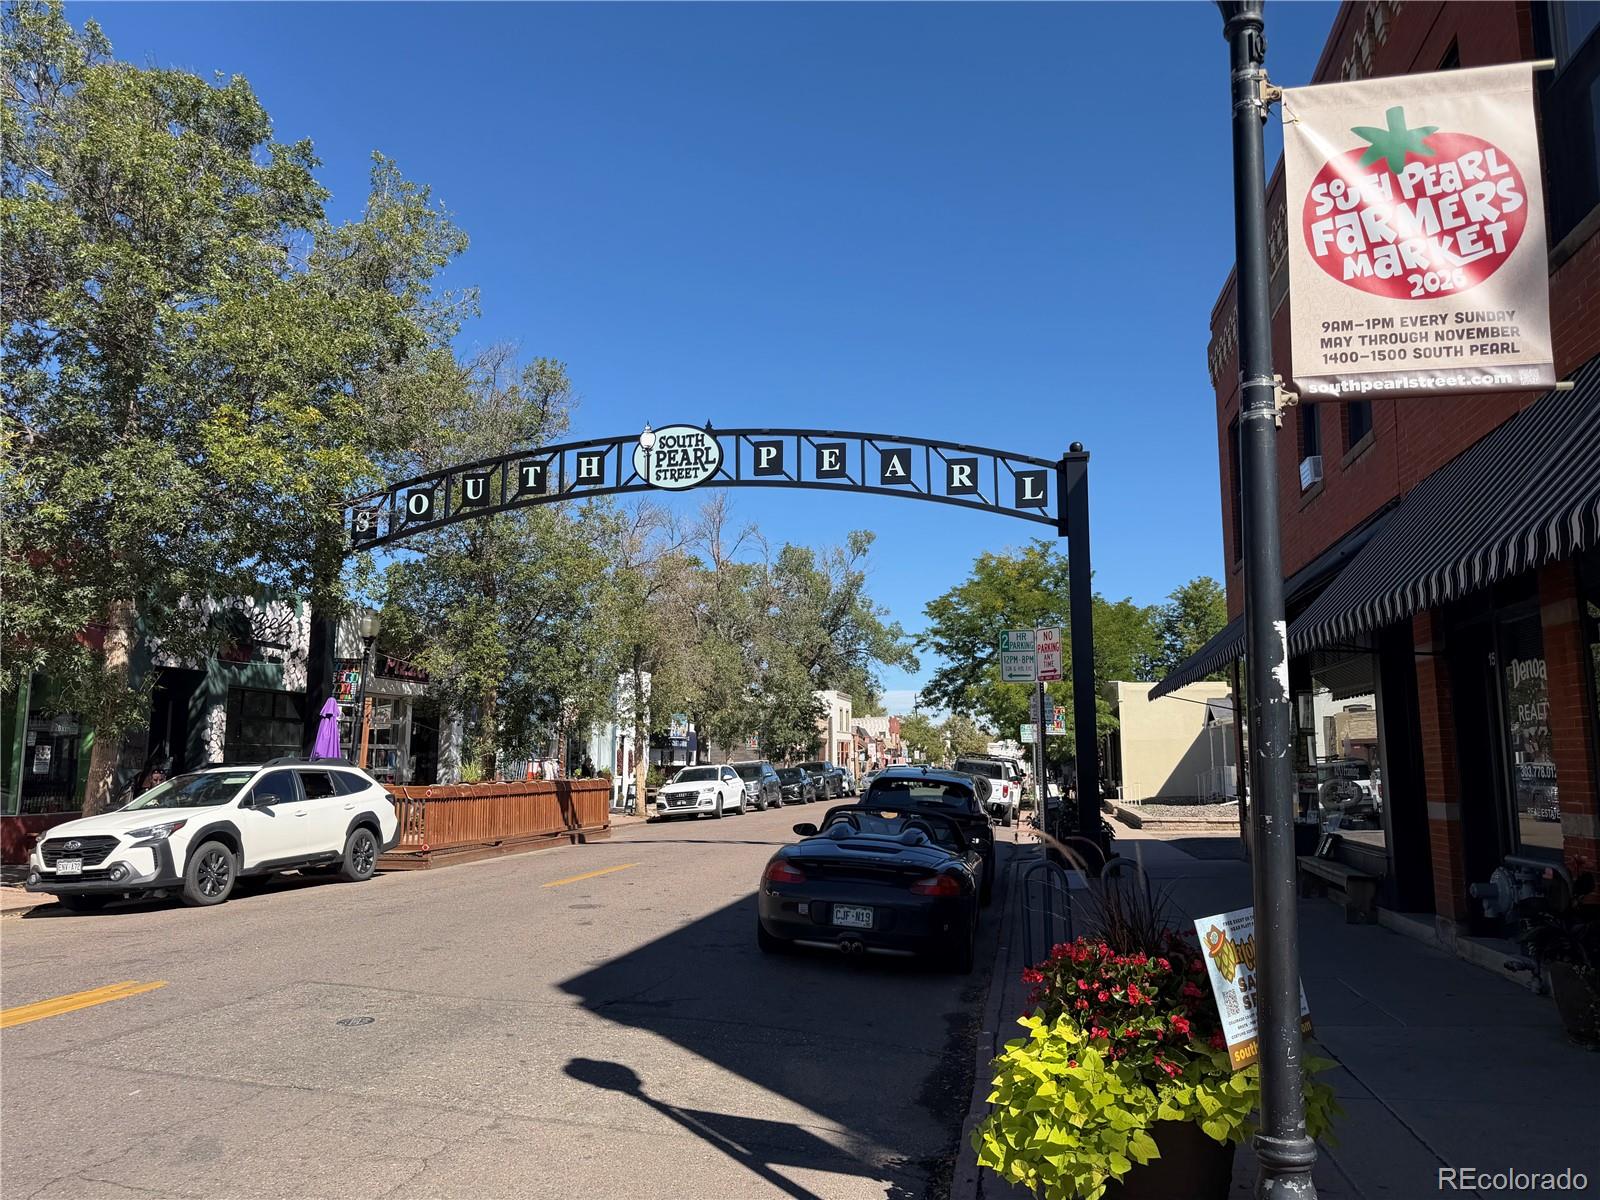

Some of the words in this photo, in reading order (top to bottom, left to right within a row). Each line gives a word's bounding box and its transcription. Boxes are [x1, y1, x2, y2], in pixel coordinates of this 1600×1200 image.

[1400, 313, 1449, 328] EVERY
[1454, 310, 1516, 324] SUNDAY
[1320, 336, 1353, 349] MAY
[1358, 331, 1429, 346] THROUGH
[1434, 326, 1520, 342] NOVEMBER
[1412, 346, 1464, 360] SOUTH
[1469, 341, 1521, 357] PEARL
[1308, 373, 1513, 395] southpearlstreet.com
[658, 433, 705, 449] SOUTH
[655, 447, 716, 472] PEARL
[655, 467, 700, 482] STREET
[1001, 634, 1009, 649] 2
[1010, 641, 1035, 650] PARKING
[1016, 633, 1027, 641] HR
[1043, 631, 1053, 641] NO
[1037, 641, 1060, 653] PARKING
[1043, 660, 1054, 668] TIME
